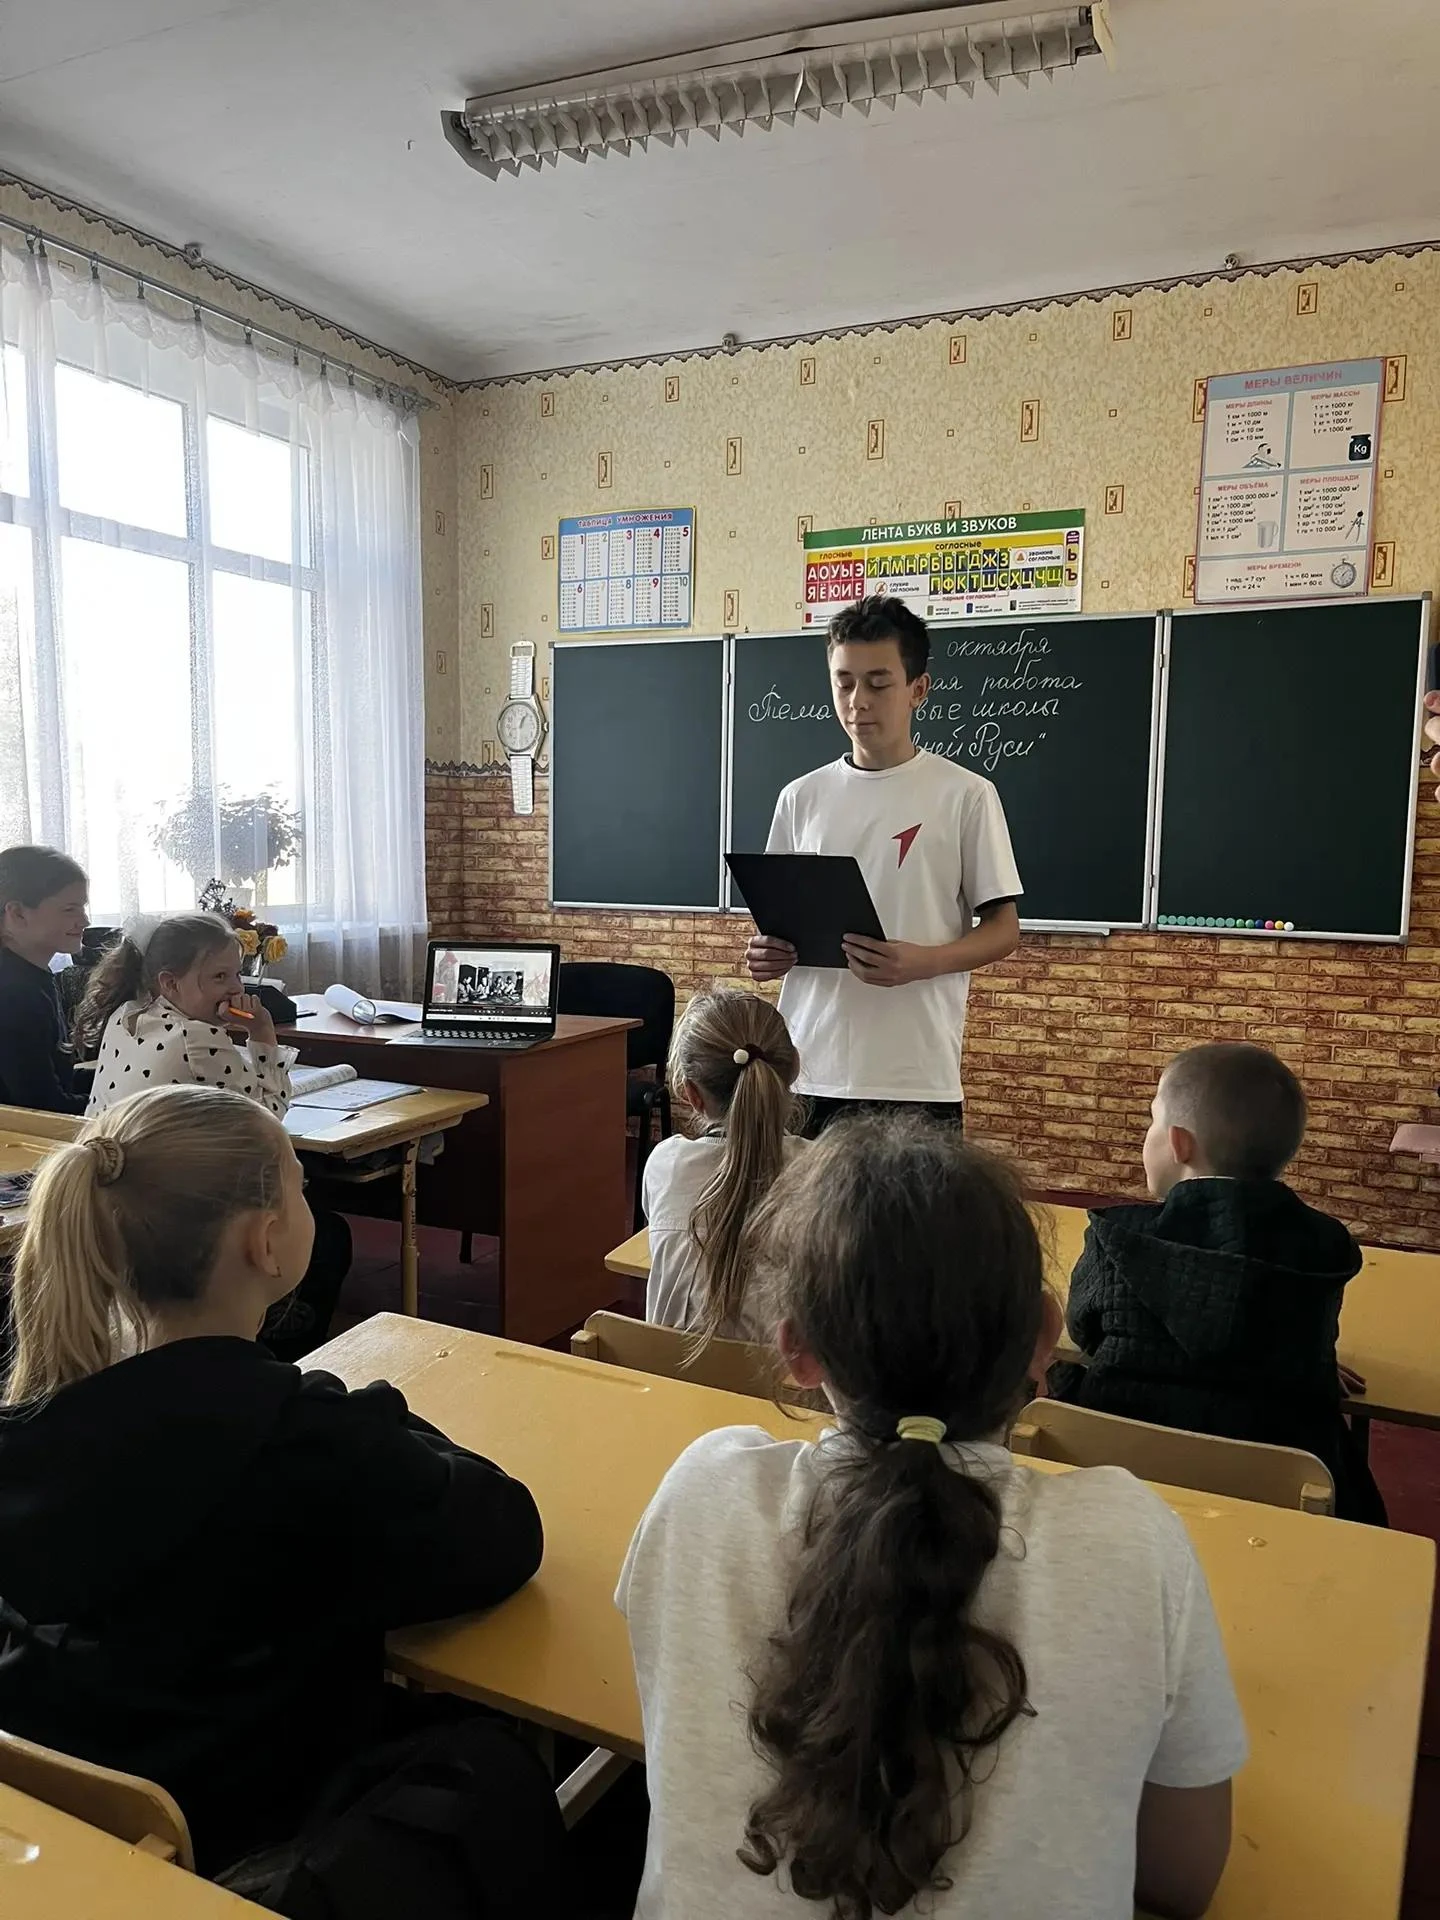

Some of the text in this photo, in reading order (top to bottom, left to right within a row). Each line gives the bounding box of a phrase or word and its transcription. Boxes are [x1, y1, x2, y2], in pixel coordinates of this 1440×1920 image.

[1244, 369, 1342, 390] МЕРЫ ВЕЛИЧИН
[1354, 444, 1367, 454] Kg
[617, 512, 672, 523] УМНОЖЕНИЯ
[654, 528, 660, 538] 4
[683, 527, 689, 536] 5
[862, 517, 1016, 541] ЛЕНТА БУКВ И ЗВУКОВ
[602, 533, 607, 542] 2
[626, 530, 632, 540] 3
[935, 541, 982, 550] согласные
[820, 552, 852, 560] гласные
[1068, 548, 1077, 561] Ь
[1065, 568, 1077, 580] Ъ
[626, 580, 631, 589] 8
[653, 578, 658, 587] 9
[680, 576, 688, 586] 10
[577, 584, 582, 593] 6
[947, 628, 1052, 674] октября
[981, 659, 1082, 696] работа
[748, 684, 1058, 722] Тема вые школы
